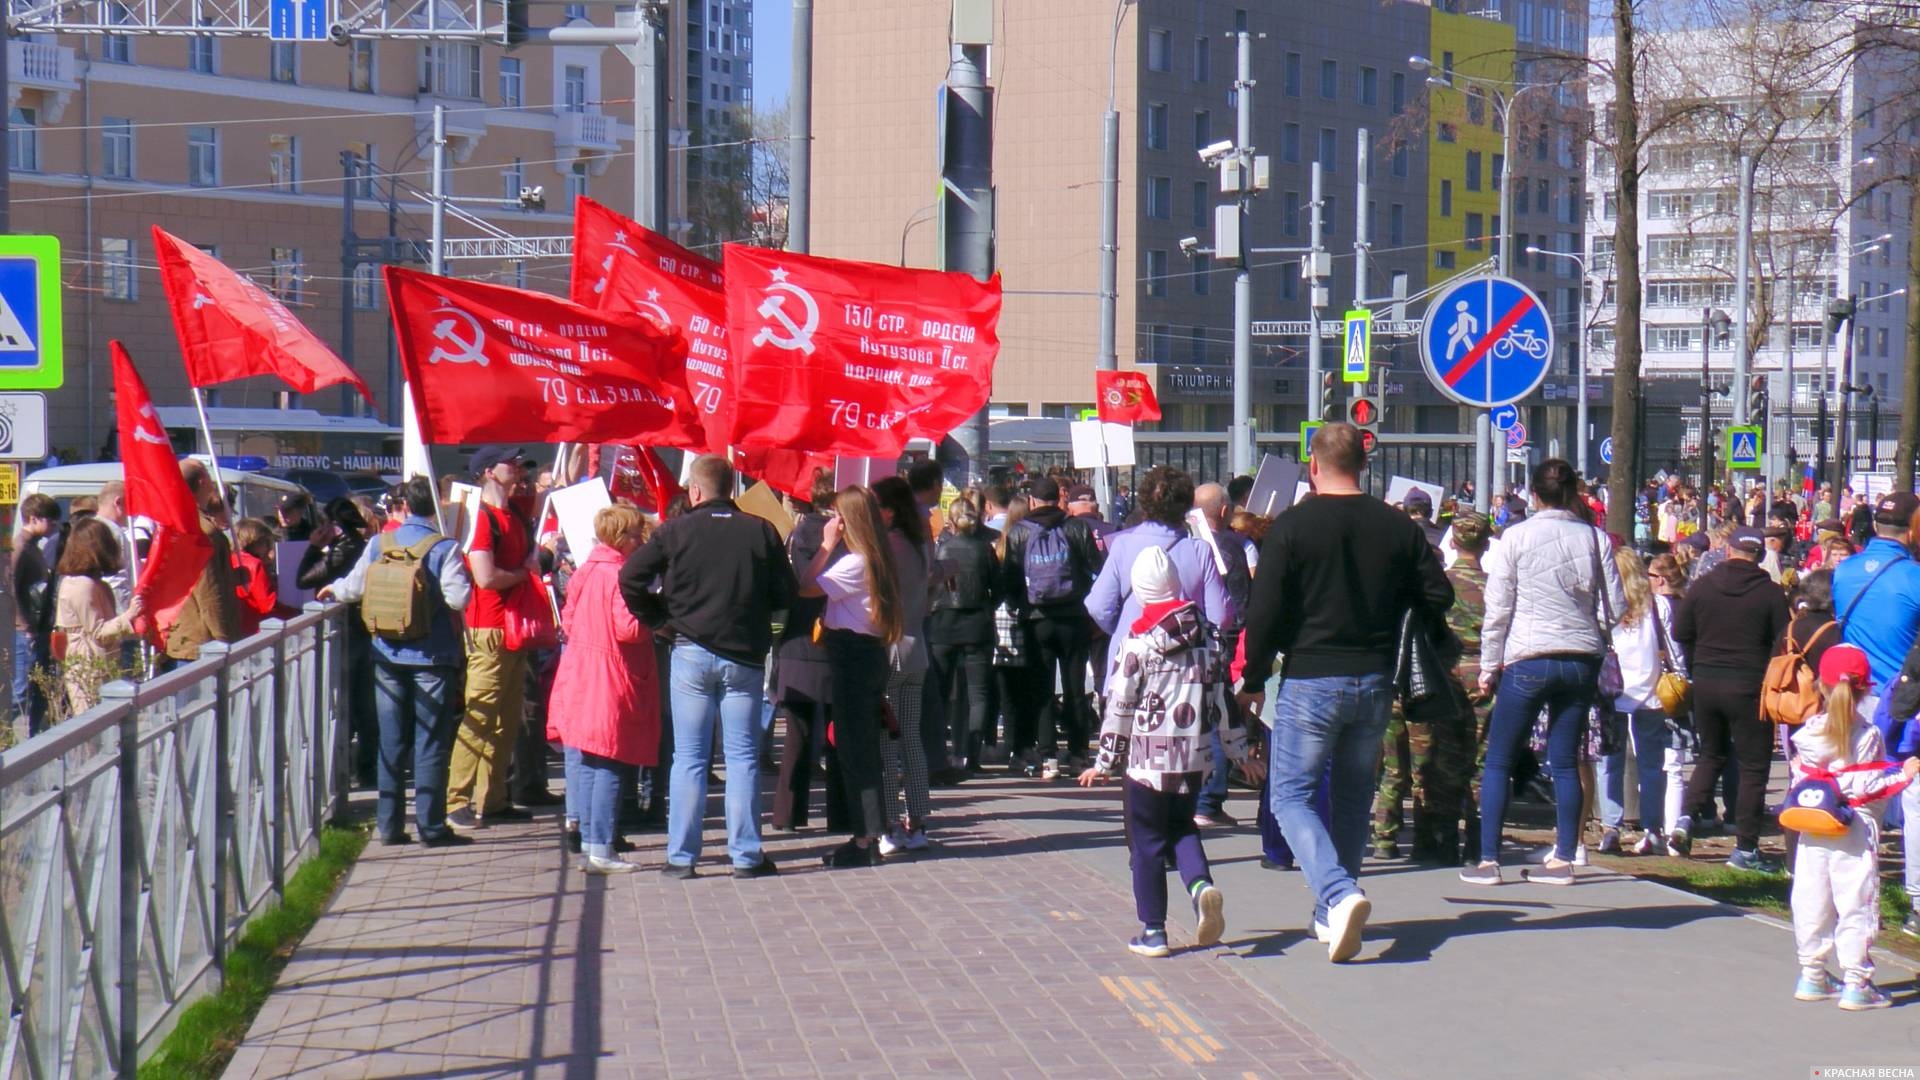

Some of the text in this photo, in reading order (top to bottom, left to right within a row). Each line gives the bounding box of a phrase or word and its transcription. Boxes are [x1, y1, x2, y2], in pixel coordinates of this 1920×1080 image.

[559, 324, 608, 337] ОРДЕНА
[689, 315, 710, 334] 150
[844, 304, 976, 344] 150 СТР. ОРДЕНА
[536, 376, 567, 406] 79
[1169, 374, 1220, 388] TRIUMPH
[694, 381, 722, 414] 79
[829, 399, 861, 429] 79
[273, 455, 331, 470] АВТОБУС
[343, 455, 371, 471] НАШ
